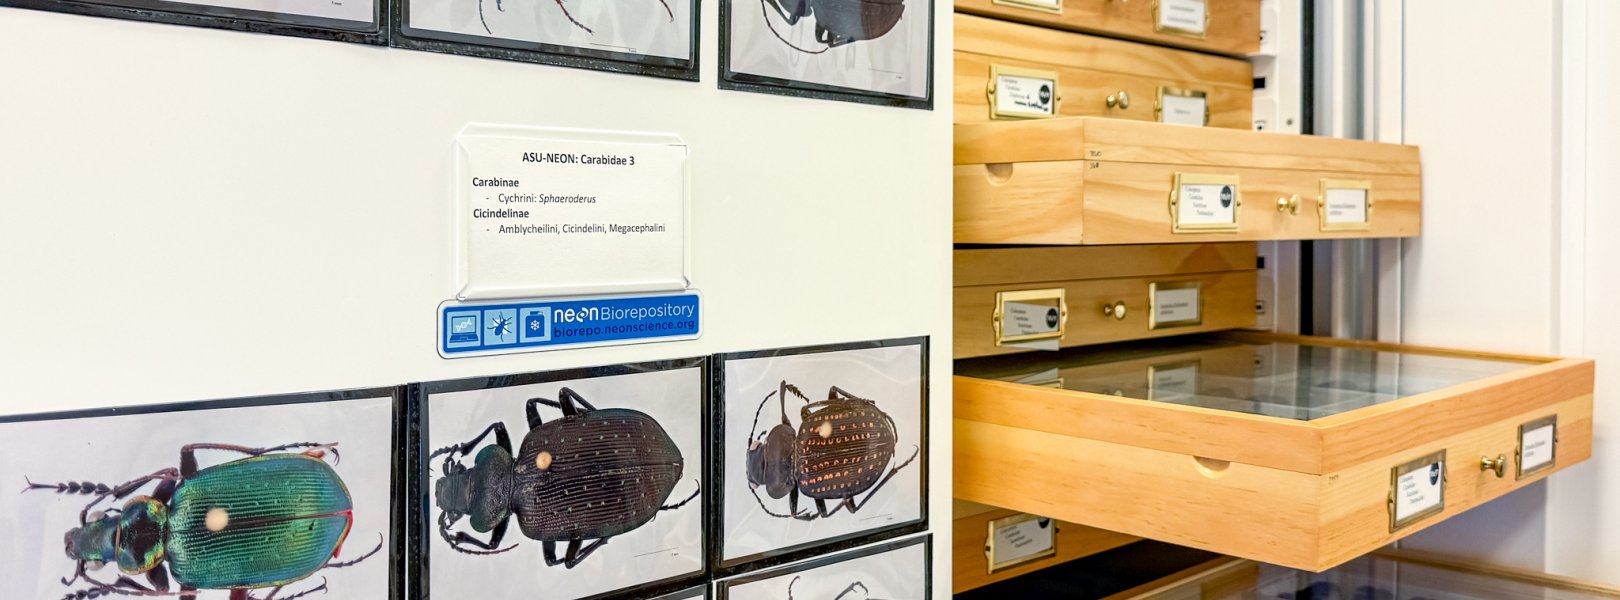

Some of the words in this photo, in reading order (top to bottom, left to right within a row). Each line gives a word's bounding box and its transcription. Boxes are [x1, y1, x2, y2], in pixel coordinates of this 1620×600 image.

[522, 151, 579, 164] ASU-NEON:
[580, 153, 628, 166] Carabidae
[629, 155, 636, 166] 3
[472, 176, 520, 188] Carabinae
[498, 192, 537, 205] Cychrini:
[538, 193, 597, 205] Sphaeroderus
[472, 207, 530, 219] Cicindelinae
[498, 223, 561, 236] Amblycheilini,
[562, 223, 608, 235] Cicindelini,
[609, 223, 666, 236] Megacephalini
[554, 307, 598, 323] neon
[602, 304, 695, 321] Biorepository
[554, 320, 695, 338] biorepo.neonscience.org
